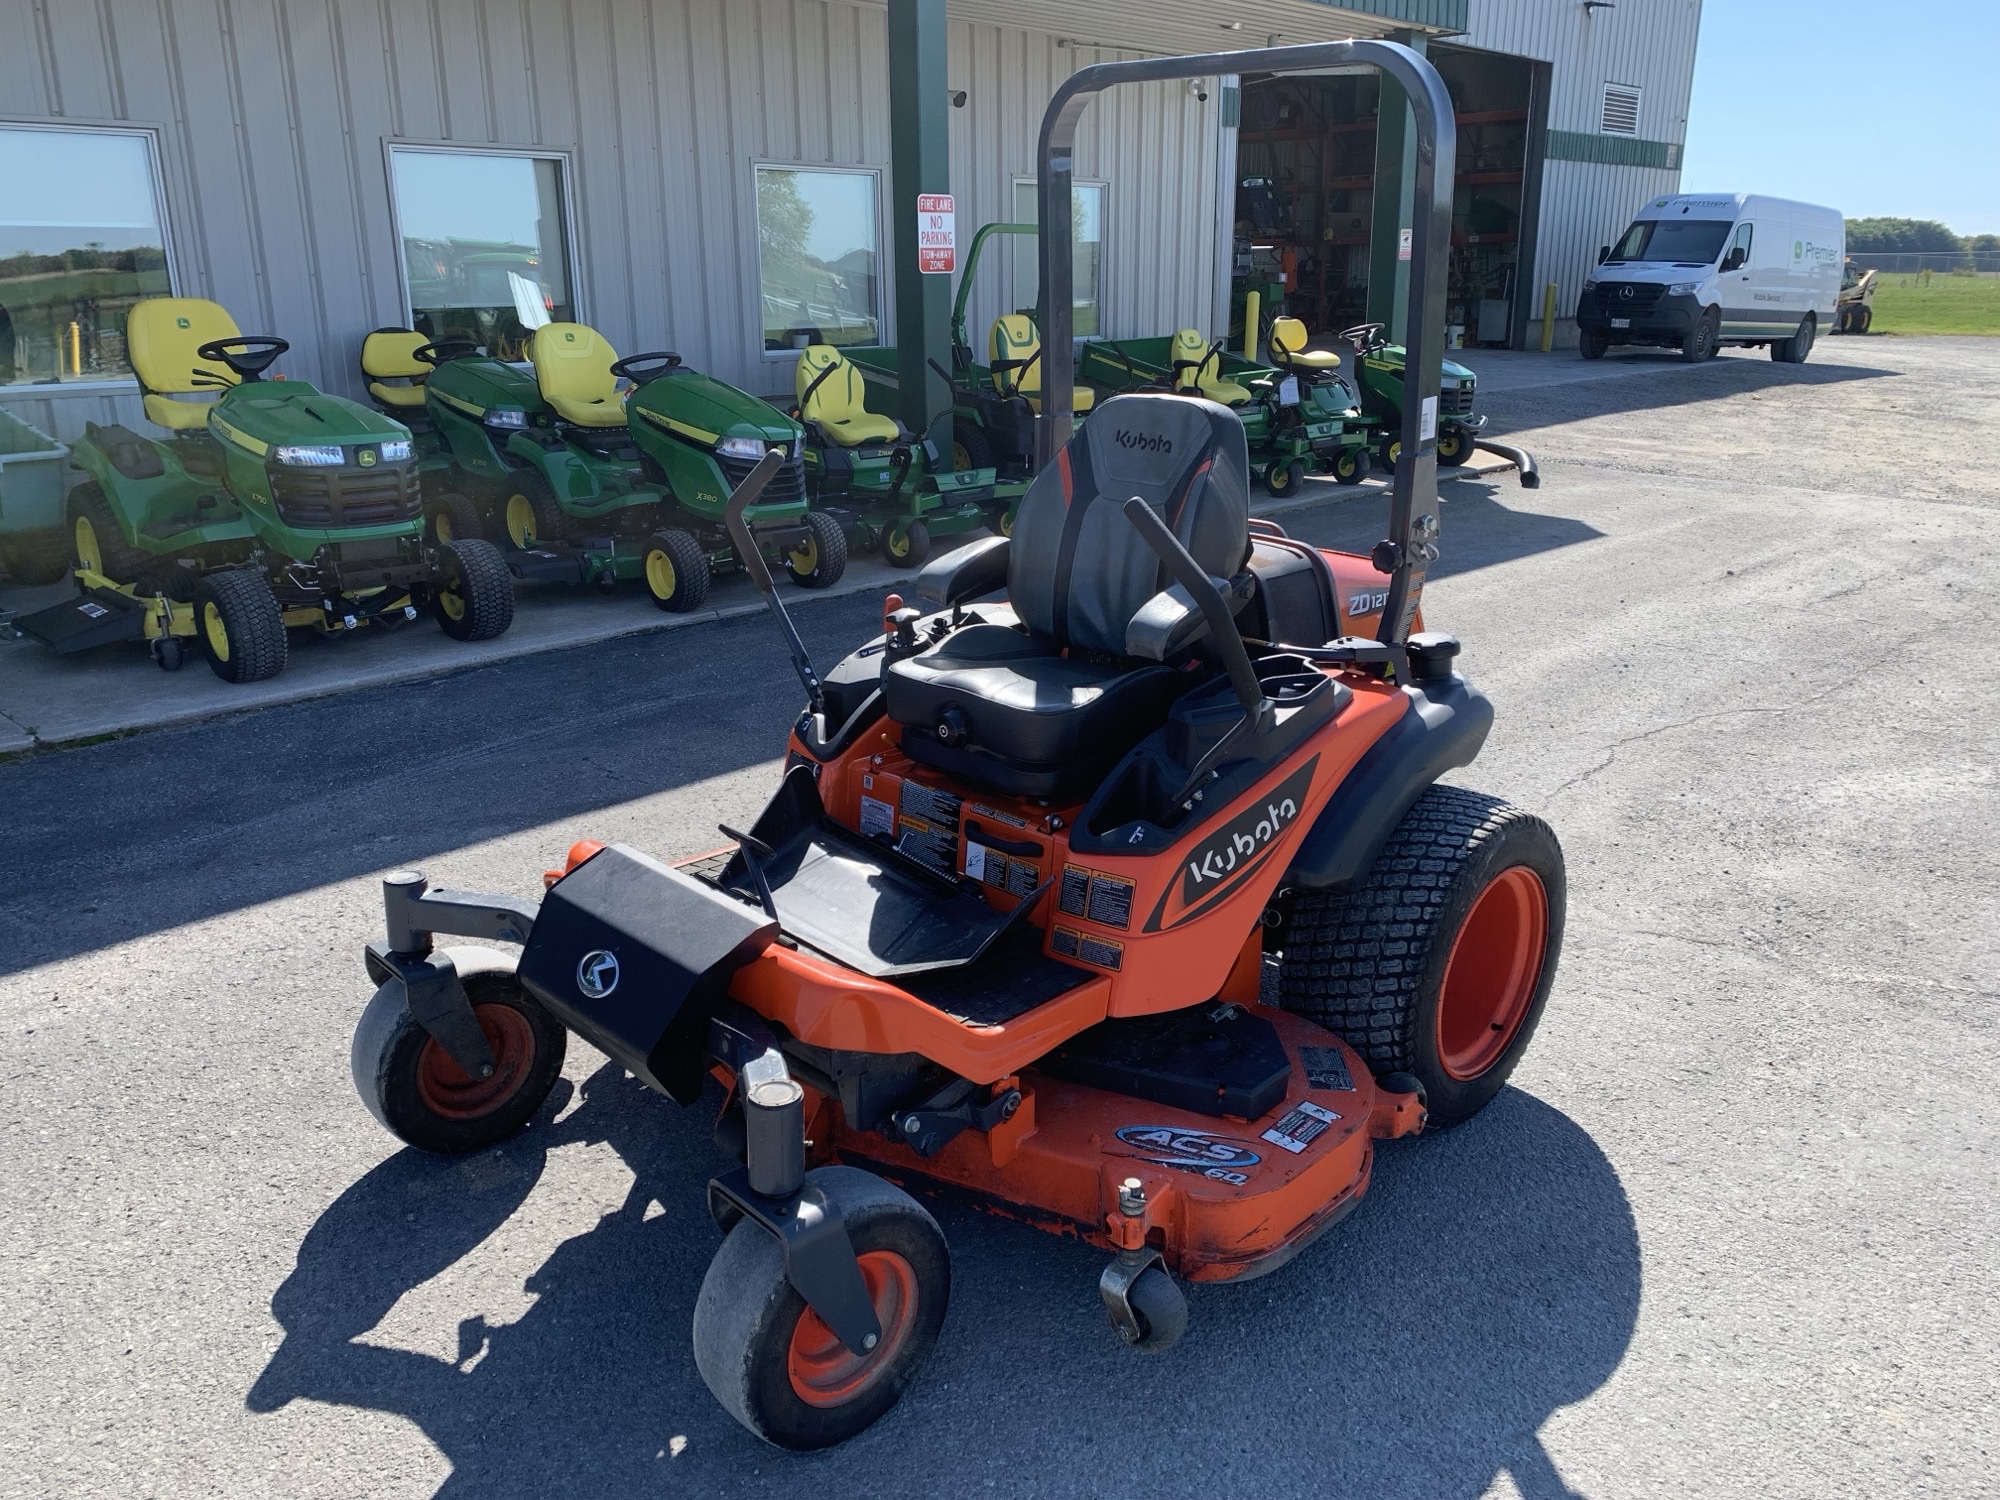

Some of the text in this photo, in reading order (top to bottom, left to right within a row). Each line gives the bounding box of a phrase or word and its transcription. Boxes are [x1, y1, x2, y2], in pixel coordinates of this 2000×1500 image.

[920, 198, 952, 211] FIRE LANE
[1672, 199, 1731, 207] Premier
[930, 215, 943, 230] NO
[921, 231, 952, 246] PARKING
[922, 249, 952, 260] TOW-AWAY
[1805, 241, 1838, 262] Premier
[929, 260, 946, 270] ZONE
[1115, 429, 1173, 454] Kubota
[251, 492, 267, 505] X750
[695, 491, 718, 503] X380
[1348, 591, 1390, 617] ZD121
[1189, 798, 1297, 884] Kubota
[1136, 1130, 1244, 1160] ACS
[1204, 1168, 1248, 1183] 60
